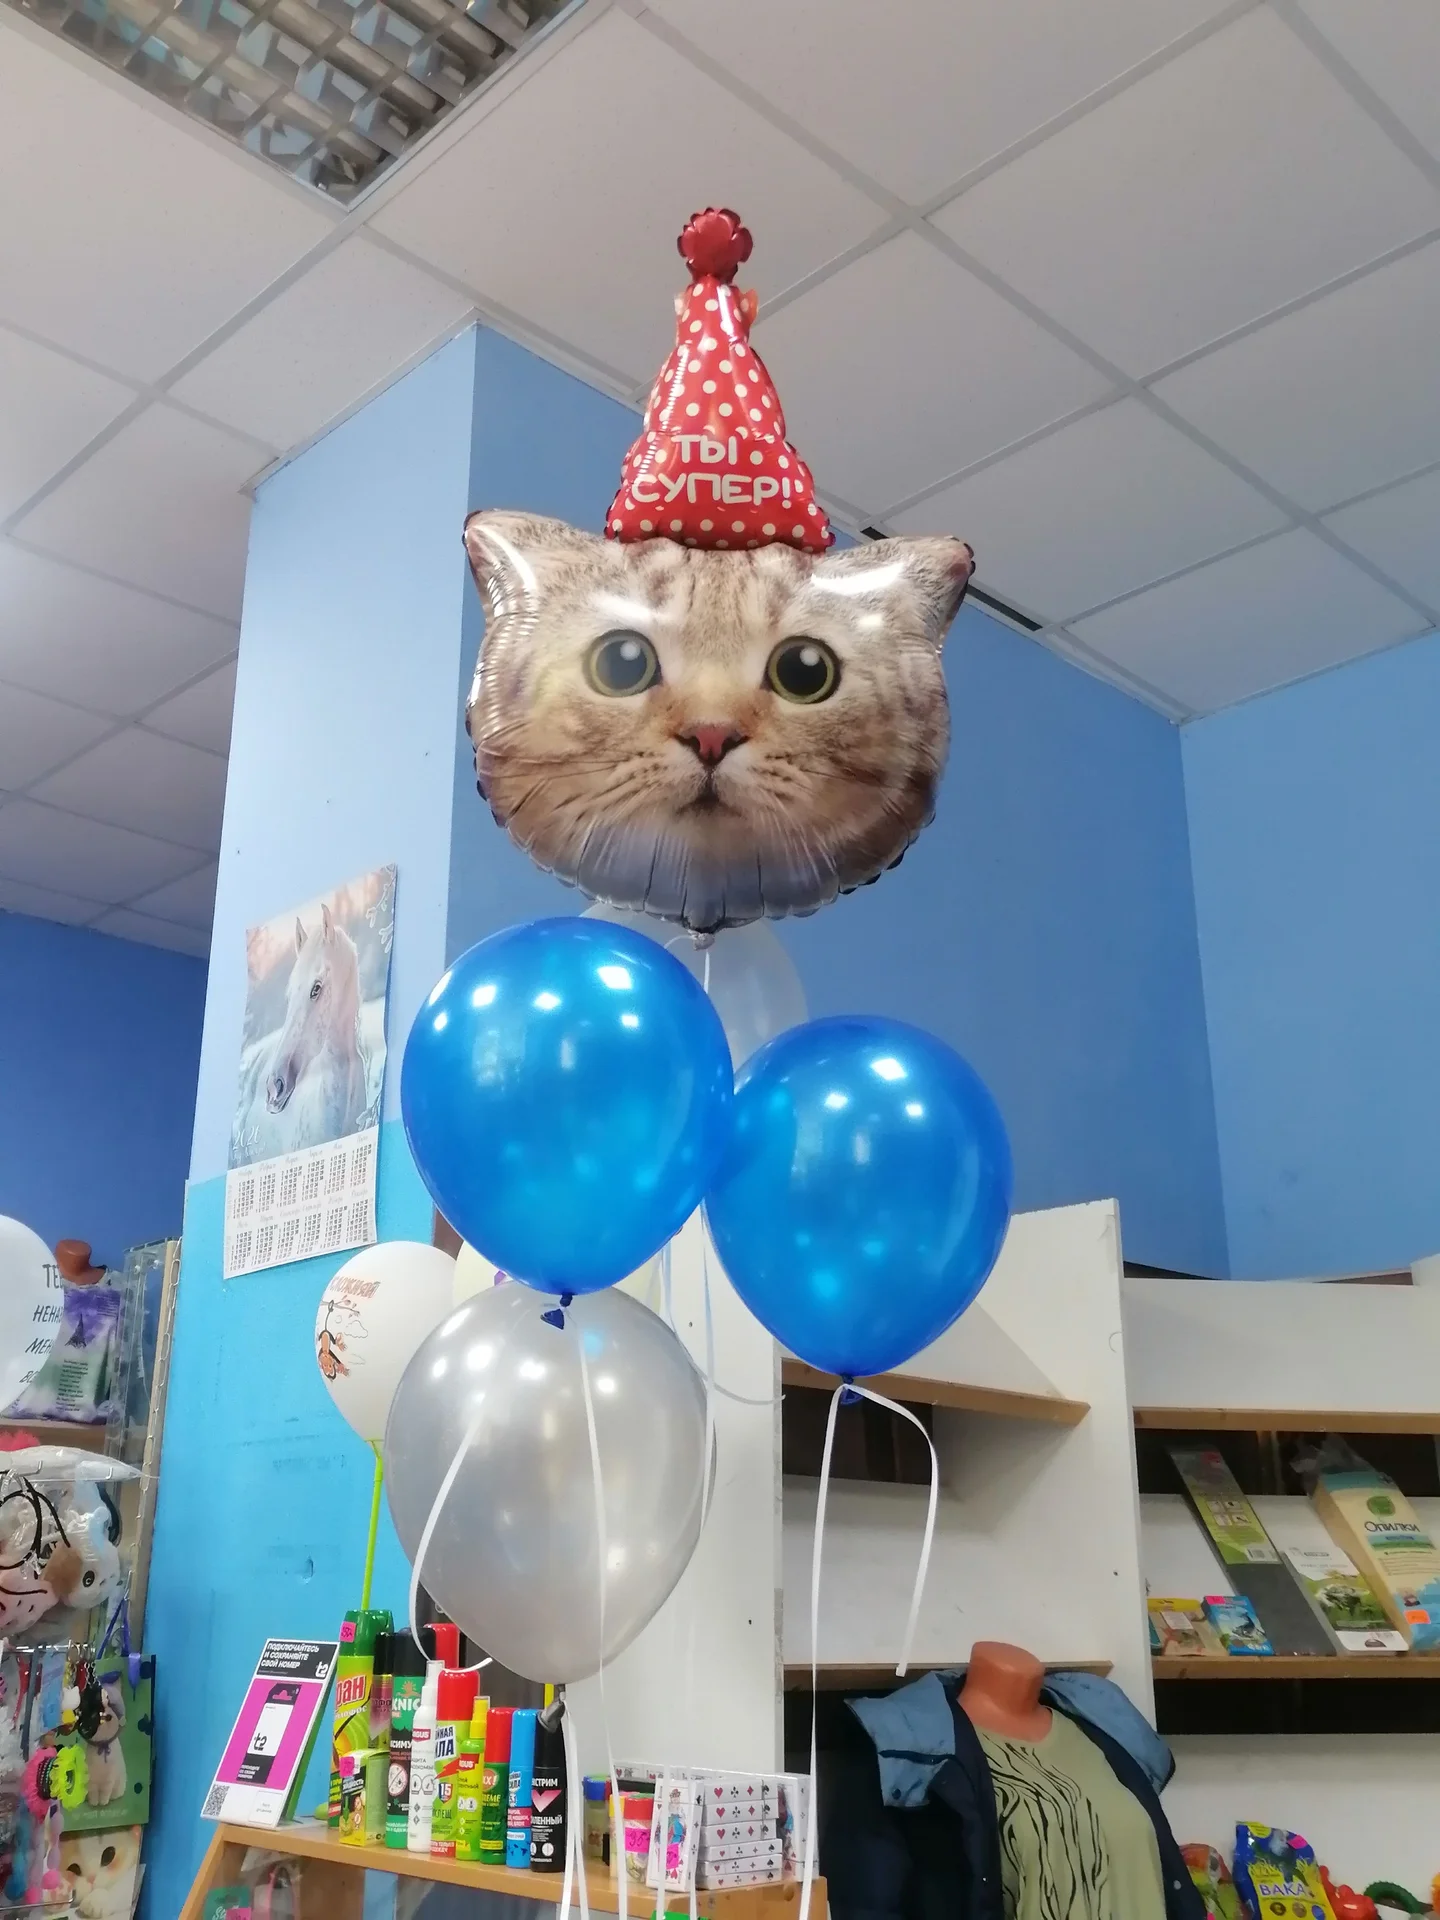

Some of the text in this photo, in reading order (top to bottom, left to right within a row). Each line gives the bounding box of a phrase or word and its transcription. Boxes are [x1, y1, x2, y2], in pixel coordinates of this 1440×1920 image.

[670, 434, 738, 466] ТЫ
[631, 472, 792, 509] СУПЕР!
[267, 1642, 320, 1653] ПОДКЛЮЧАЙТЕСЬ
[270, 1651, 309, 1661] СОХРАНЯЙТЕ
[260, 1658, 301, 1669] СВОЙ НОМЕР
[440, 1783, 452, 1795] 15
